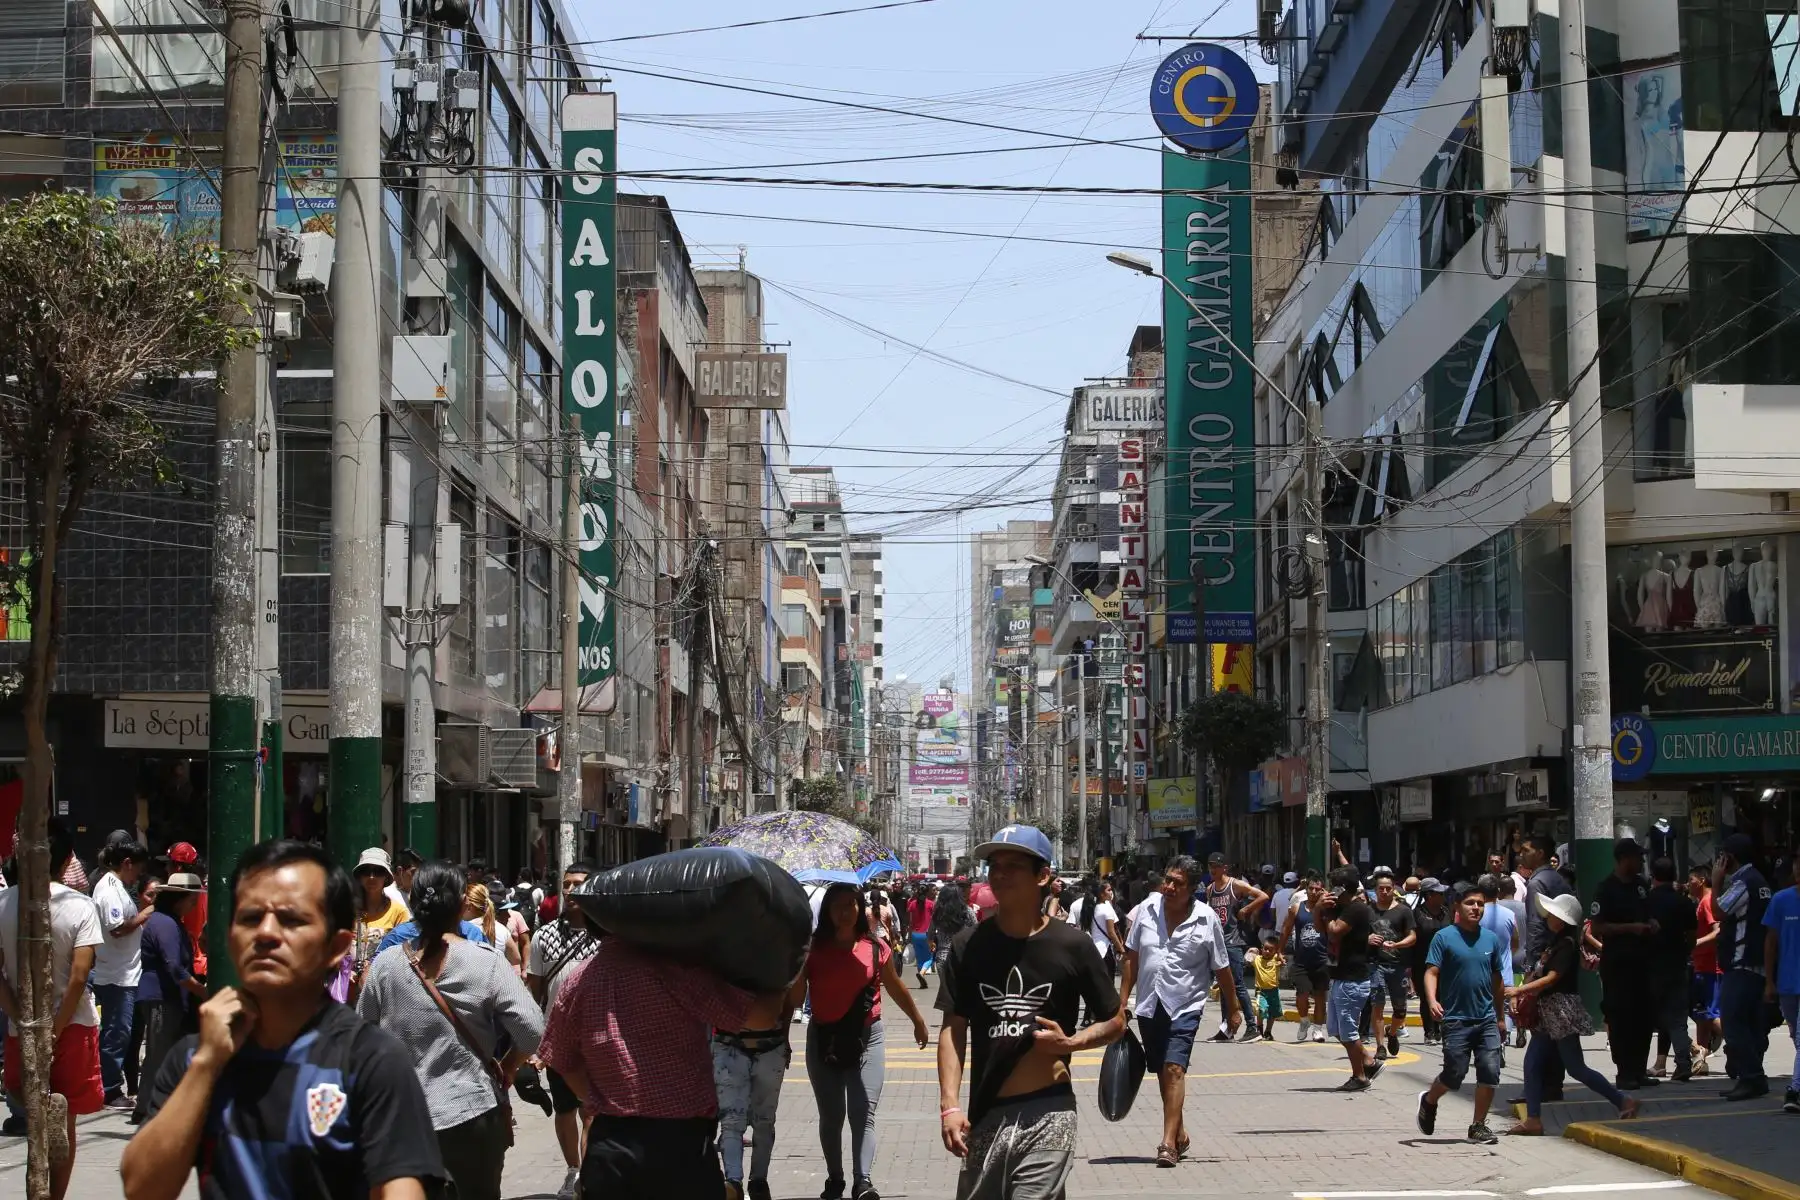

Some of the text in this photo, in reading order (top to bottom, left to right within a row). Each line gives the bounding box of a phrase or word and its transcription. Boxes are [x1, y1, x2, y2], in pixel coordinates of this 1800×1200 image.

[1158, 50, 1205, 94] CENTRO
[569, 147, 612, 624] SALOMON
[700, 360, 782, 397] GALERIAS
[1186, 181, 1235, 586] CENTRO GAMARRA
[1092, 396, 1165, 421] GALERIAS
[1120, 440, 1143, 588] SANTA
[1708, 686, 1742, 696] BOUTIQUE
[111, 708, 135, 735] La
[1611, 717, 1643, 736] TRO
[1662, 734, 1729, 759] CENTRO
